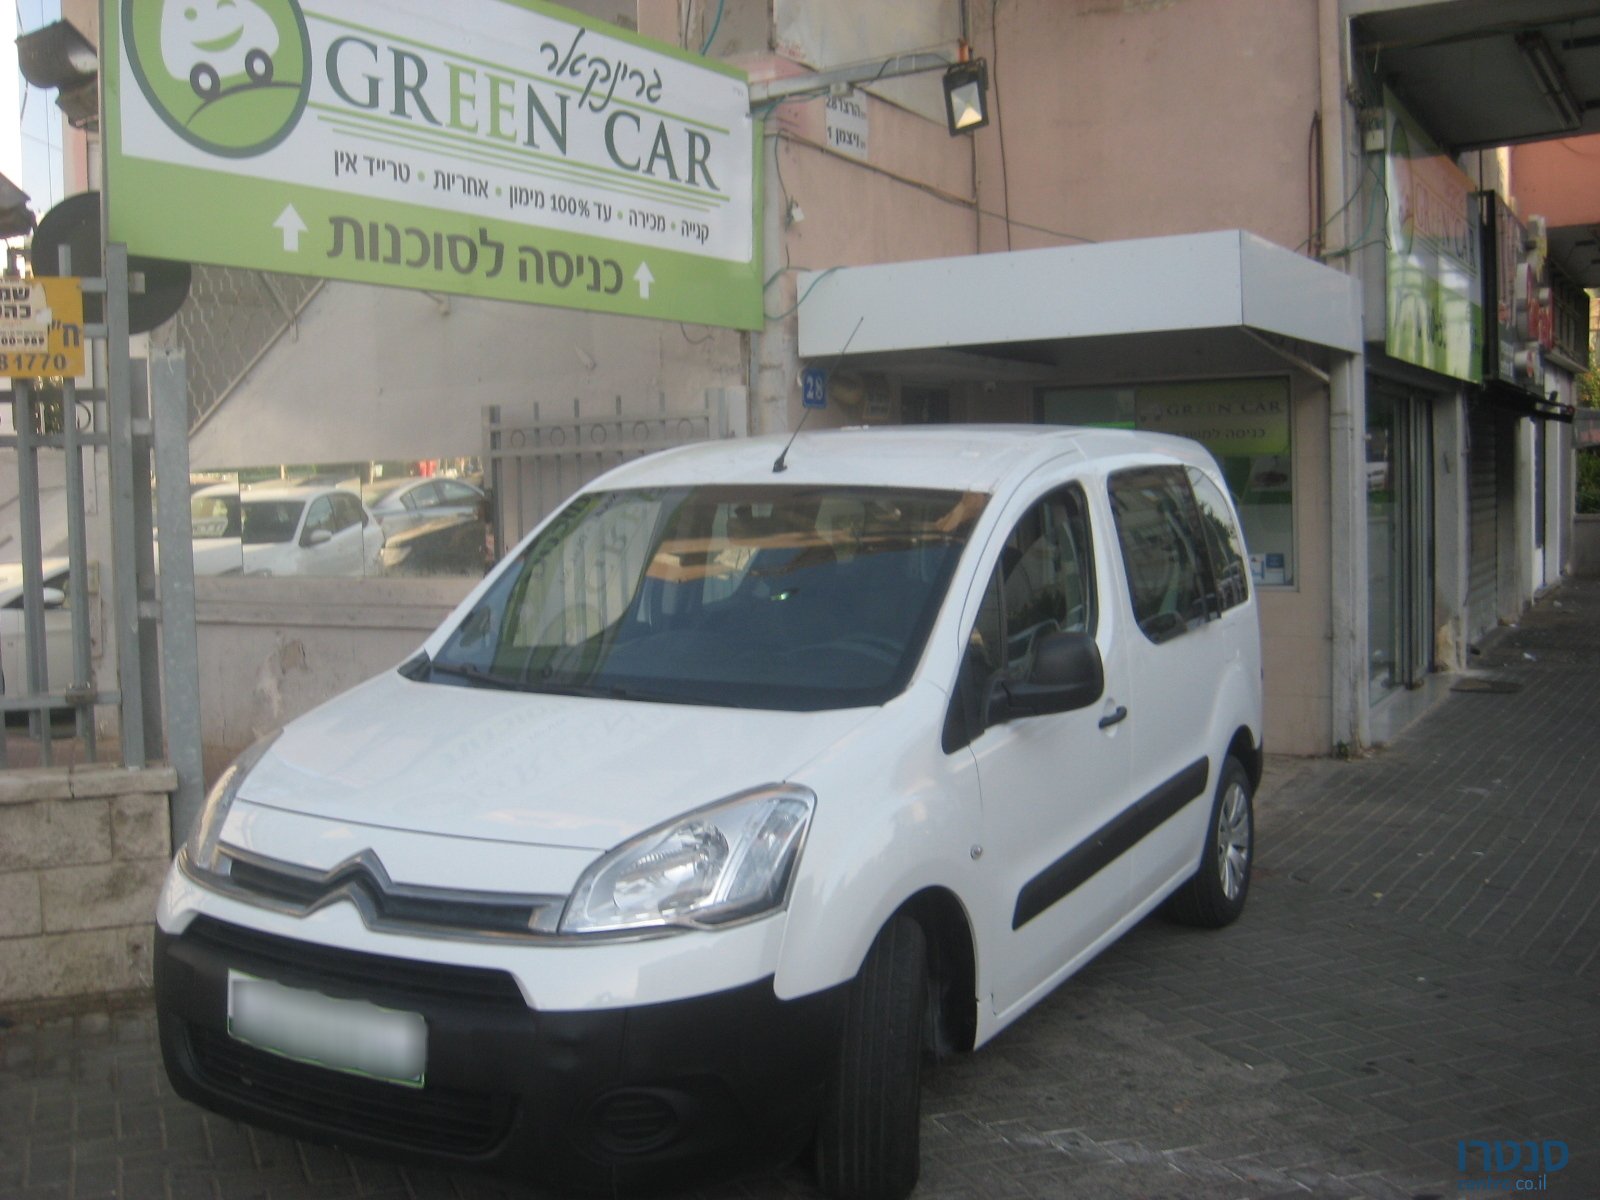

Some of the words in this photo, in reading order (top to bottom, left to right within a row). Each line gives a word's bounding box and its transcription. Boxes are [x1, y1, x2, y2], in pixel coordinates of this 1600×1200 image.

[325, 35, 571, 156] GREEN
[604, 109, 721, 191] CAR
[836, 128, 859, 147] ויצמן
[334, 149, 358, 177] אין
[362, 155, 411, 183] טרייד
[433, 168, 489, 199] אחריות
[509, 185, 545, 209] מימון
[550, 193, 590, 218] 100%
[593, 202, 612, 222] עד
[628, 208, 667, 233] מכירה
[681, 219, 710, 245] קנייה
[326, 215, 505, 278] לסוכנות
[518, 245, 623, 295] כניסה
[806, 376, 823, 400] 28
[1240, 400, 1281, 414] CAR
